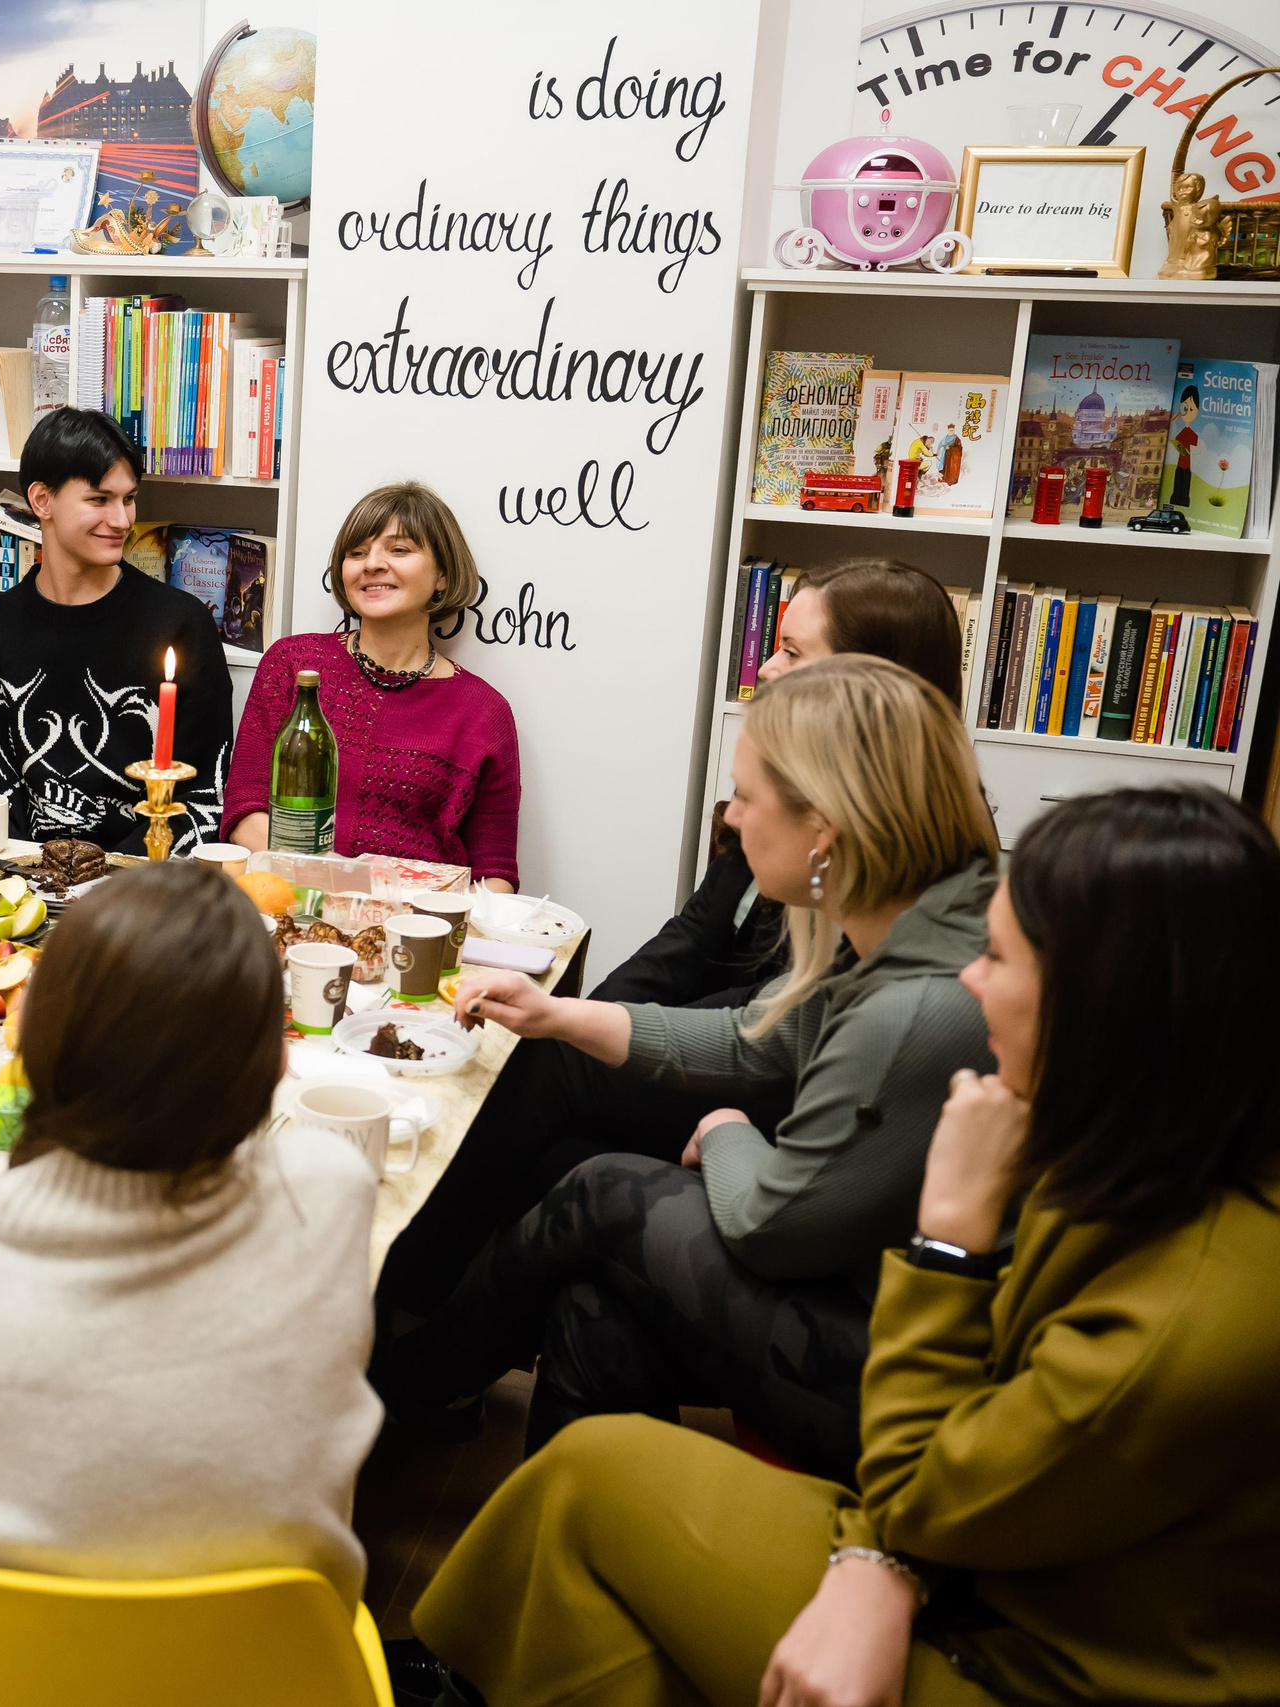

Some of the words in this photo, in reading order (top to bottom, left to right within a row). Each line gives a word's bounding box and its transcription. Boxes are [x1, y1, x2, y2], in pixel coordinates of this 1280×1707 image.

[529, 69, 563, 120] is
[576, 35, 727, 162] doing
[857, 51, 992, 107] Time
[1012, 41, 1091, 76] for
[1102, 55, 1280, 203] CHANG
[976, 200, 1015, 216] Dare
[1018, 201, 1032, 215] to
[1036, 202, 1085, 217] dream
[1088, 204, 1113, 221] big
[338, 178, 553, 291] ordinary
[582, 178, 722, 294] things
[1049, 355, 1152, 381] London
[1081, 351, 1105, 361] inside
[327, 295, 704, 456] extraordinary
[1203, 371, 1252, 392] Science
[785, 385, 856, 406] ФЕНОМЕН
[1201, 396, 1251, 417] Children
[1240, 392, 1252, 403] for
[263, 402, 271, 426] СЧАСТЬЯ
[772, 417, 854, 438] ПОЛИГЛОТО
[499, 460, 649, 531] well
[242, 539, 261, 552] ROWLING
[183, 574, 226, 589] Classics
[754, 570, 764, 588] Dictionary
[435, 575, 576, 652] Rohn
[964, 618, 977, 647] English
[1016, 630, 1024, 652] ENGLISH
[1149, 617, 1165, 660] PRACTICE
[1092, 634, 1103, 659] Russian
[1096, 639, 1108, 665] English
[1122, 628, 1138, 690] ИЛЛЮСТРАЦИЯМИ
[1112, 650, 1127, 705] АНГЛО-РУССКИЙ
[1120, 620, 1133, 650] СЛОВАРЬ
[1142, 662, 1157, 704] GRAMMAR
[1134, 706, 1149, 743] ENGLISH
